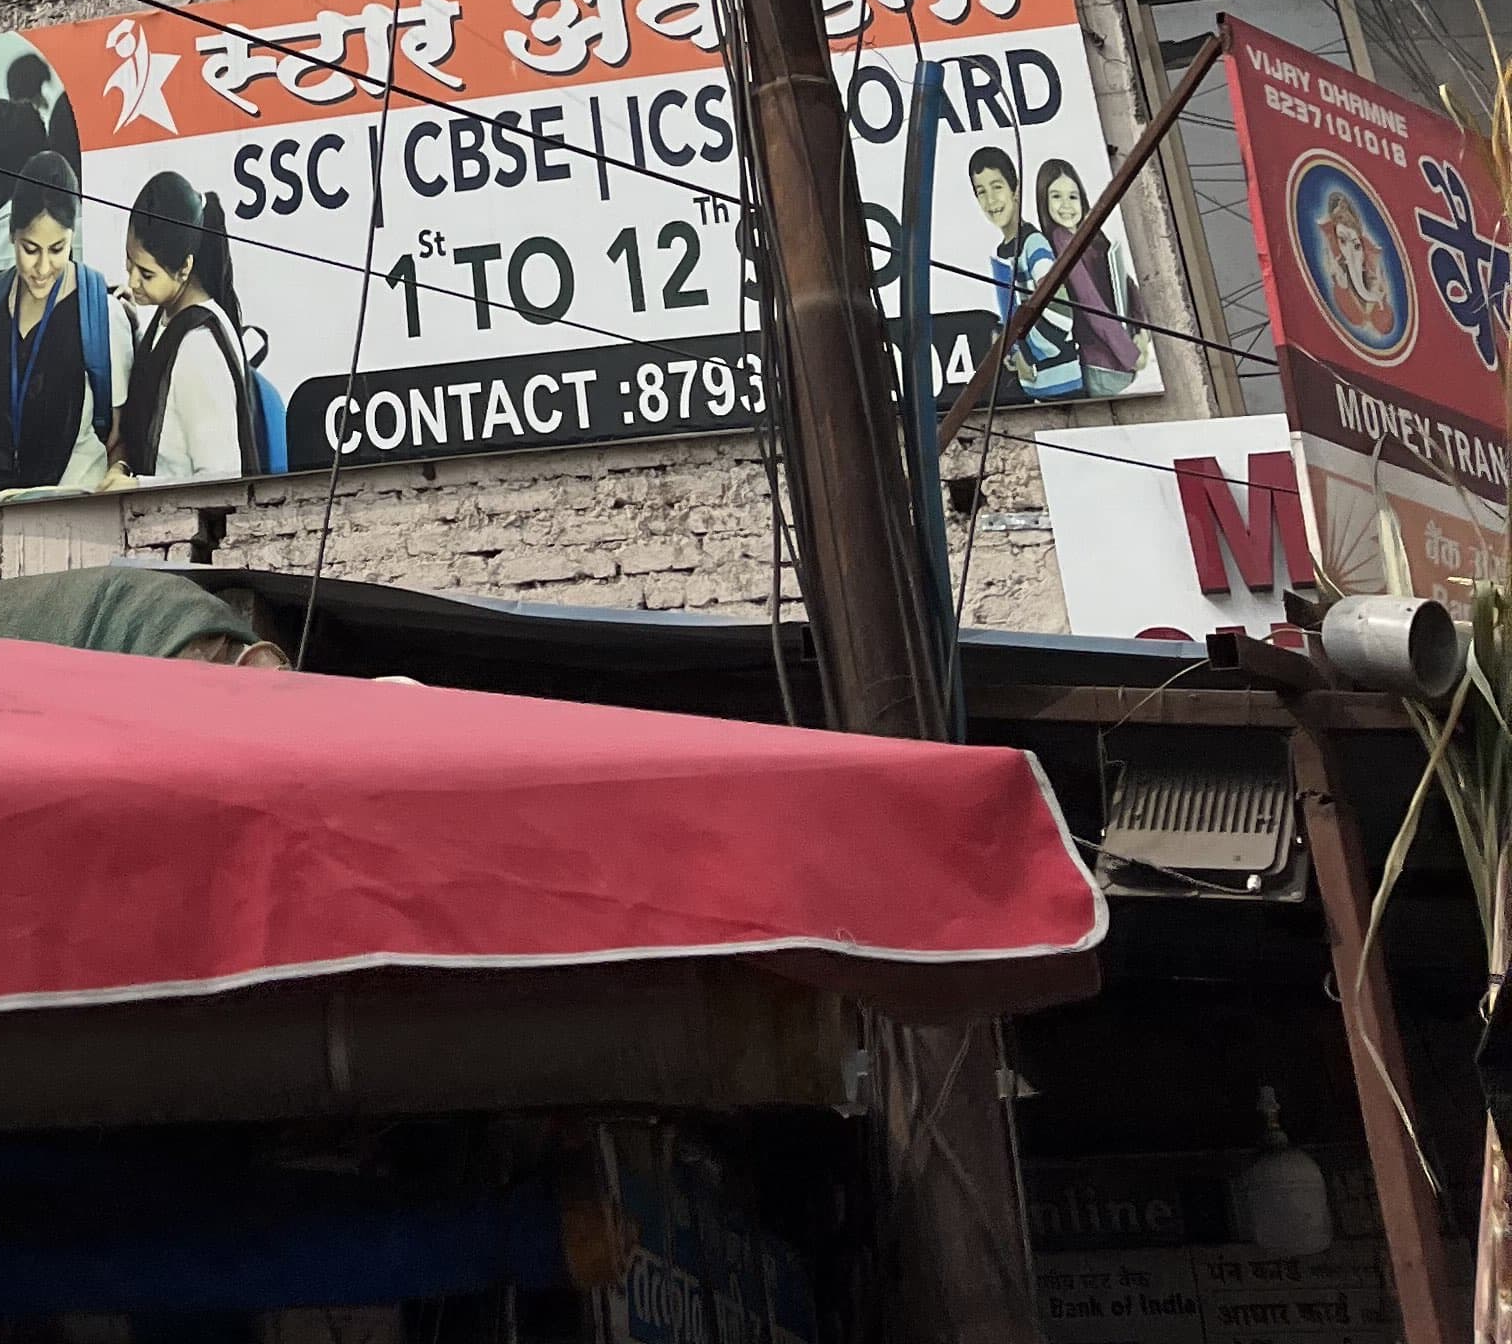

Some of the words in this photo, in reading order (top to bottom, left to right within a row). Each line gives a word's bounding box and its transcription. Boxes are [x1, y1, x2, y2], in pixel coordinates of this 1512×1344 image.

[1246, 44, 1311, 93] VIJAY
[235, 133, 350, 221] SSC
[404, 105, 572, 198] CBSE
[627, 84, 735, 170] ICS
[1264, 84, 1408, 169] 8237101018
[453, 235, 576, 331] TO
[324, 368, 599, 456] CONTACT
[1335, 383, 1433, 459] MONEY
[1437, 422, 1510, 487] TRAN
[1030, 1186, 1175, 1234] nline
